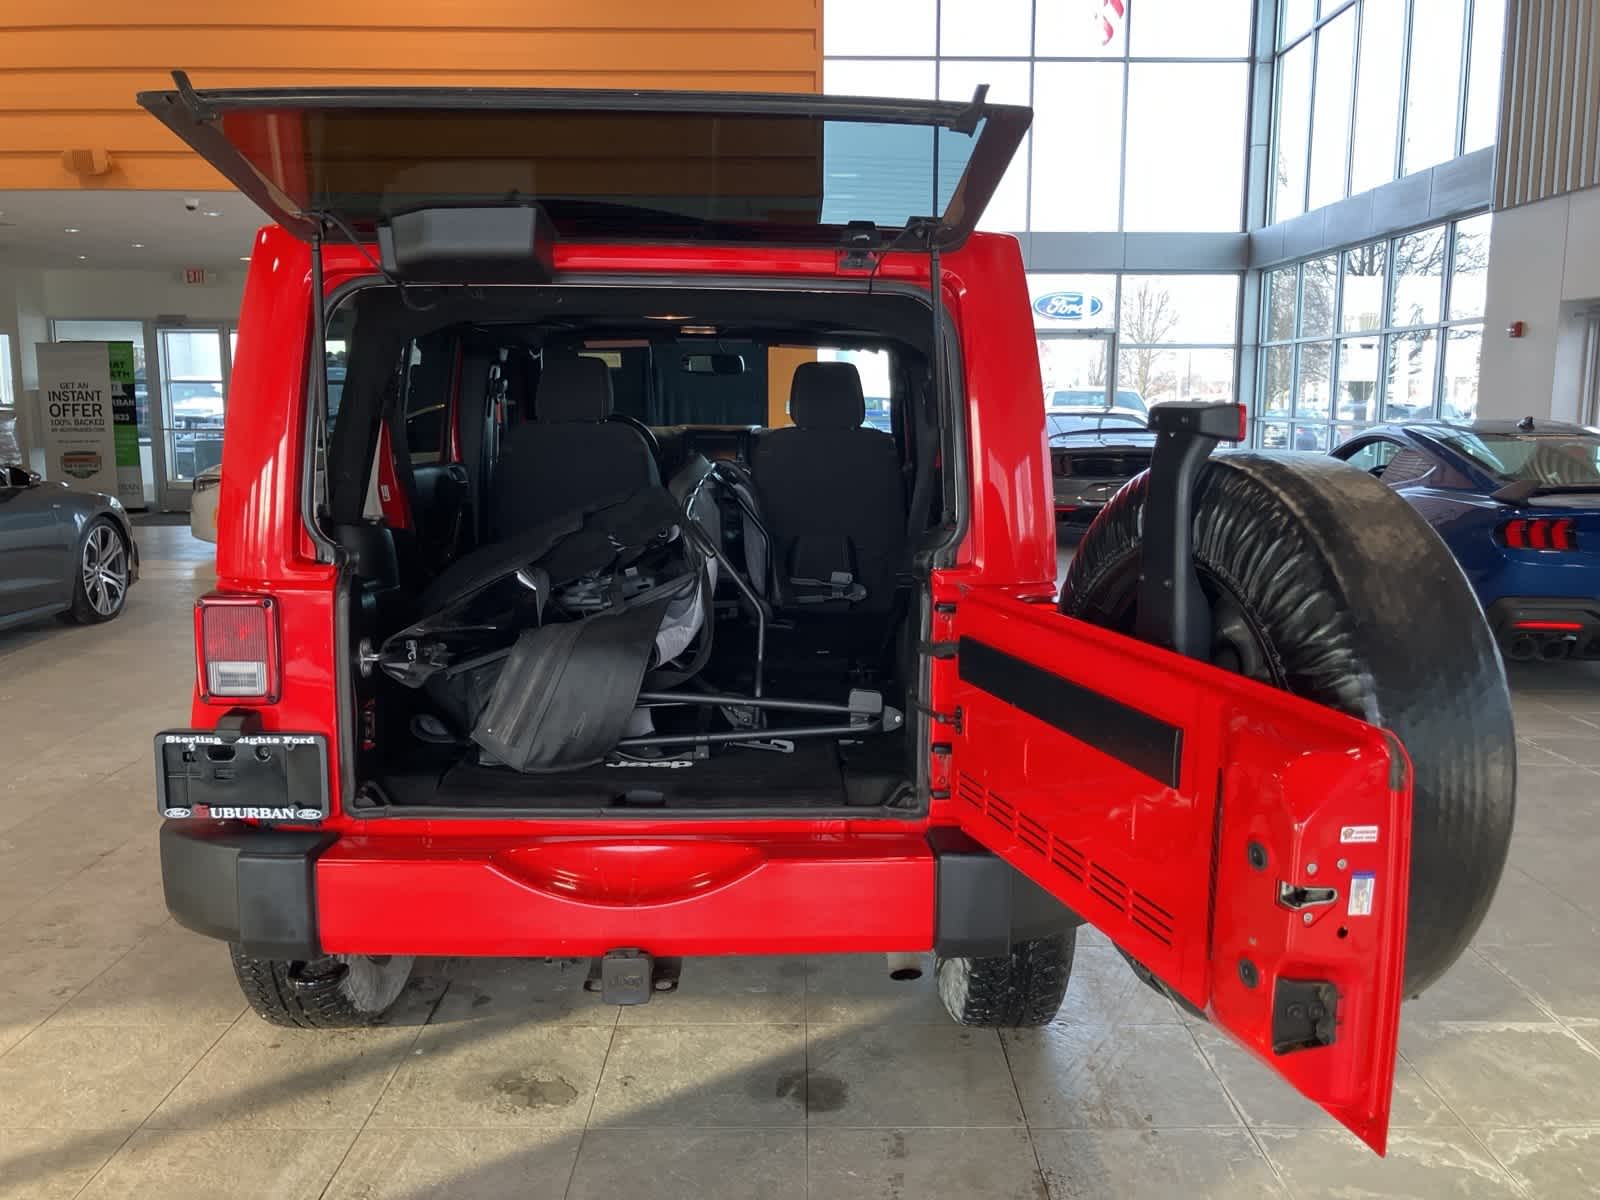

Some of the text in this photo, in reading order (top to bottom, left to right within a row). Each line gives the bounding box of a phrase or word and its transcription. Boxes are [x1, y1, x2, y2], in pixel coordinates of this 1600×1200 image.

[48, 390, 102, 401] INSTANT
[49, 403, 103, 417] OFFER
[165, 735, 315, 745] Sterling eights Ford
[193, 804, 295, 819] SUBURBAN
